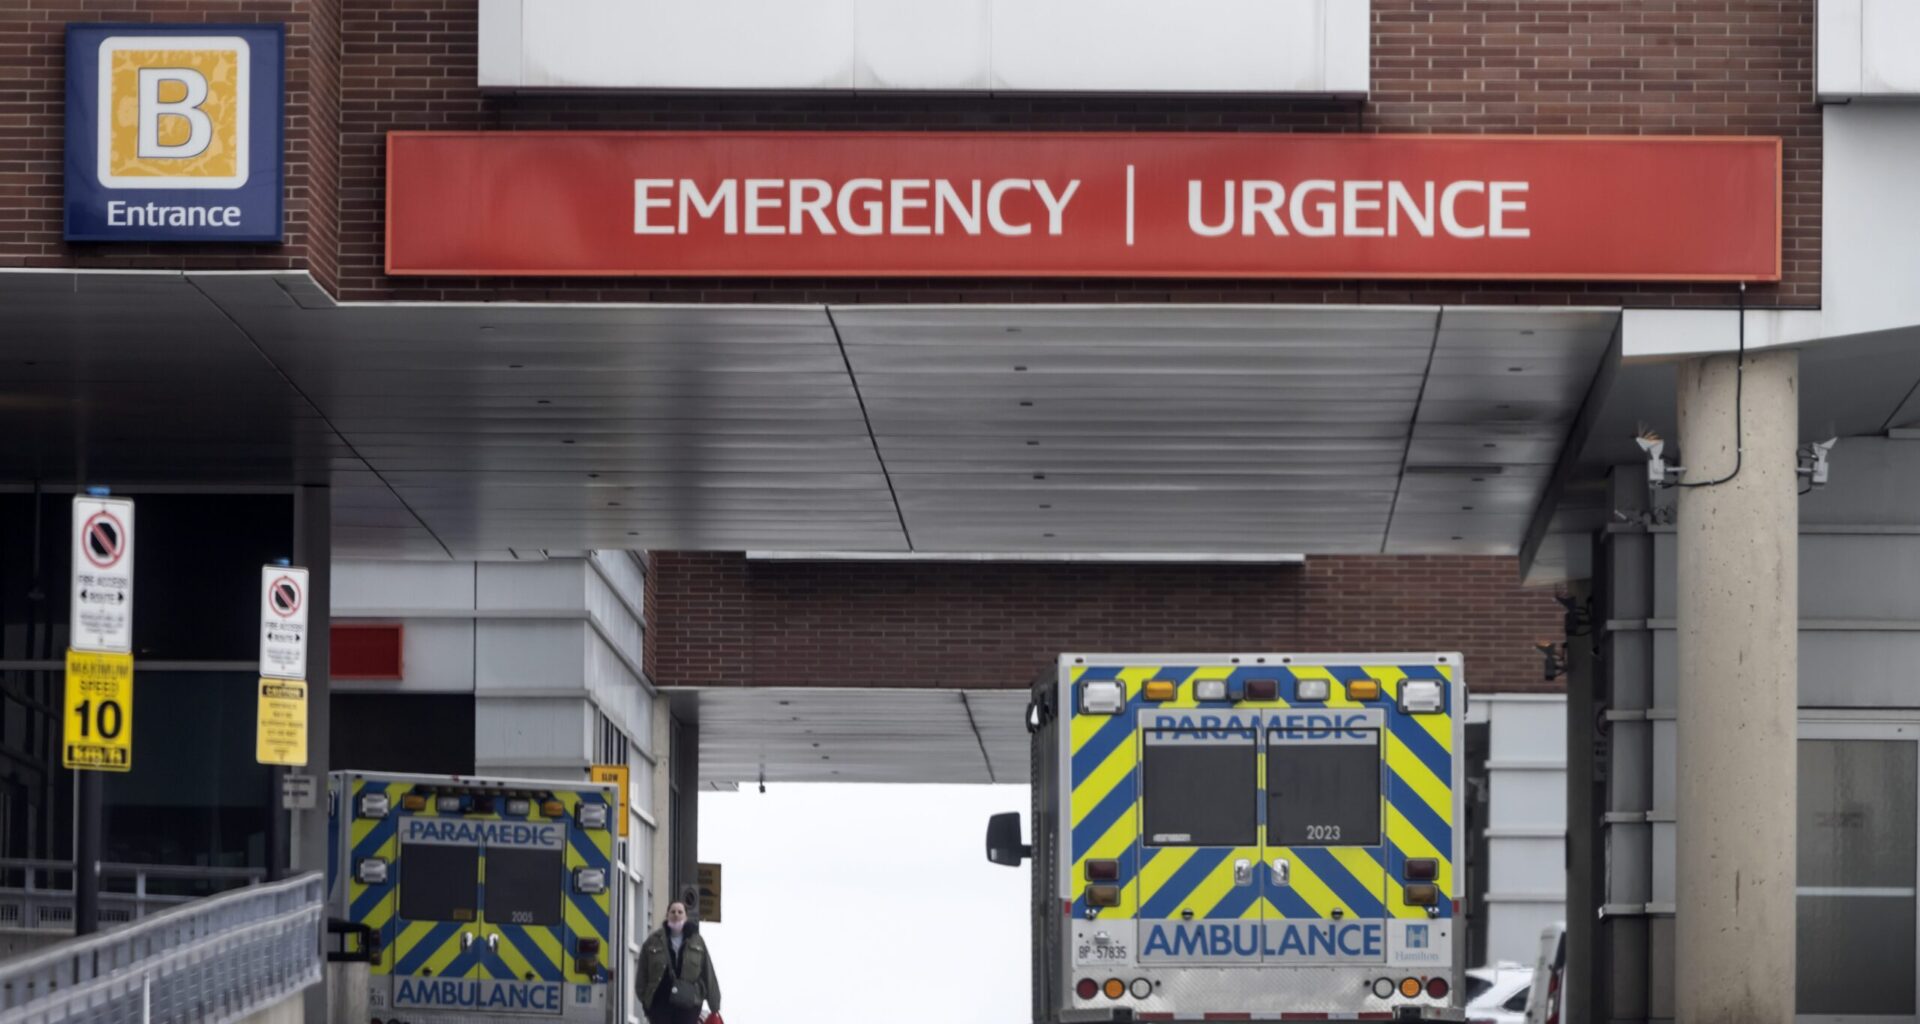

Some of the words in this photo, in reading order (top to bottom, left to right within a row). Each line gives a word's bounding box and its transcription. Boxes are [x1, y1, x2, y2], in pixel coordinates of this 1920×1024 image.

[137, 67, 213, 159] B
[107, 200, 241, 227] Entrance
[633, 178, 1081, 236] EMERGENCY
[1187, 179, 1531, 238] URGENCE
[71, 662, 129, 678] MAXIMUM
[80, 680, 119, 698] SPEED
[75, 699, 123, 740] 10
[1155, 714, 1367, 740] PARAMEDIC
[409, 821, 556, 845] PARAMEDIC
[1306, 825, 1341, 840] 2023
[1143, 923, 1382, 956] AMBULANCE
[1395, 951, 1440, 961] Hamilton
[396, 979, 559, 1010] AMBULANCE
